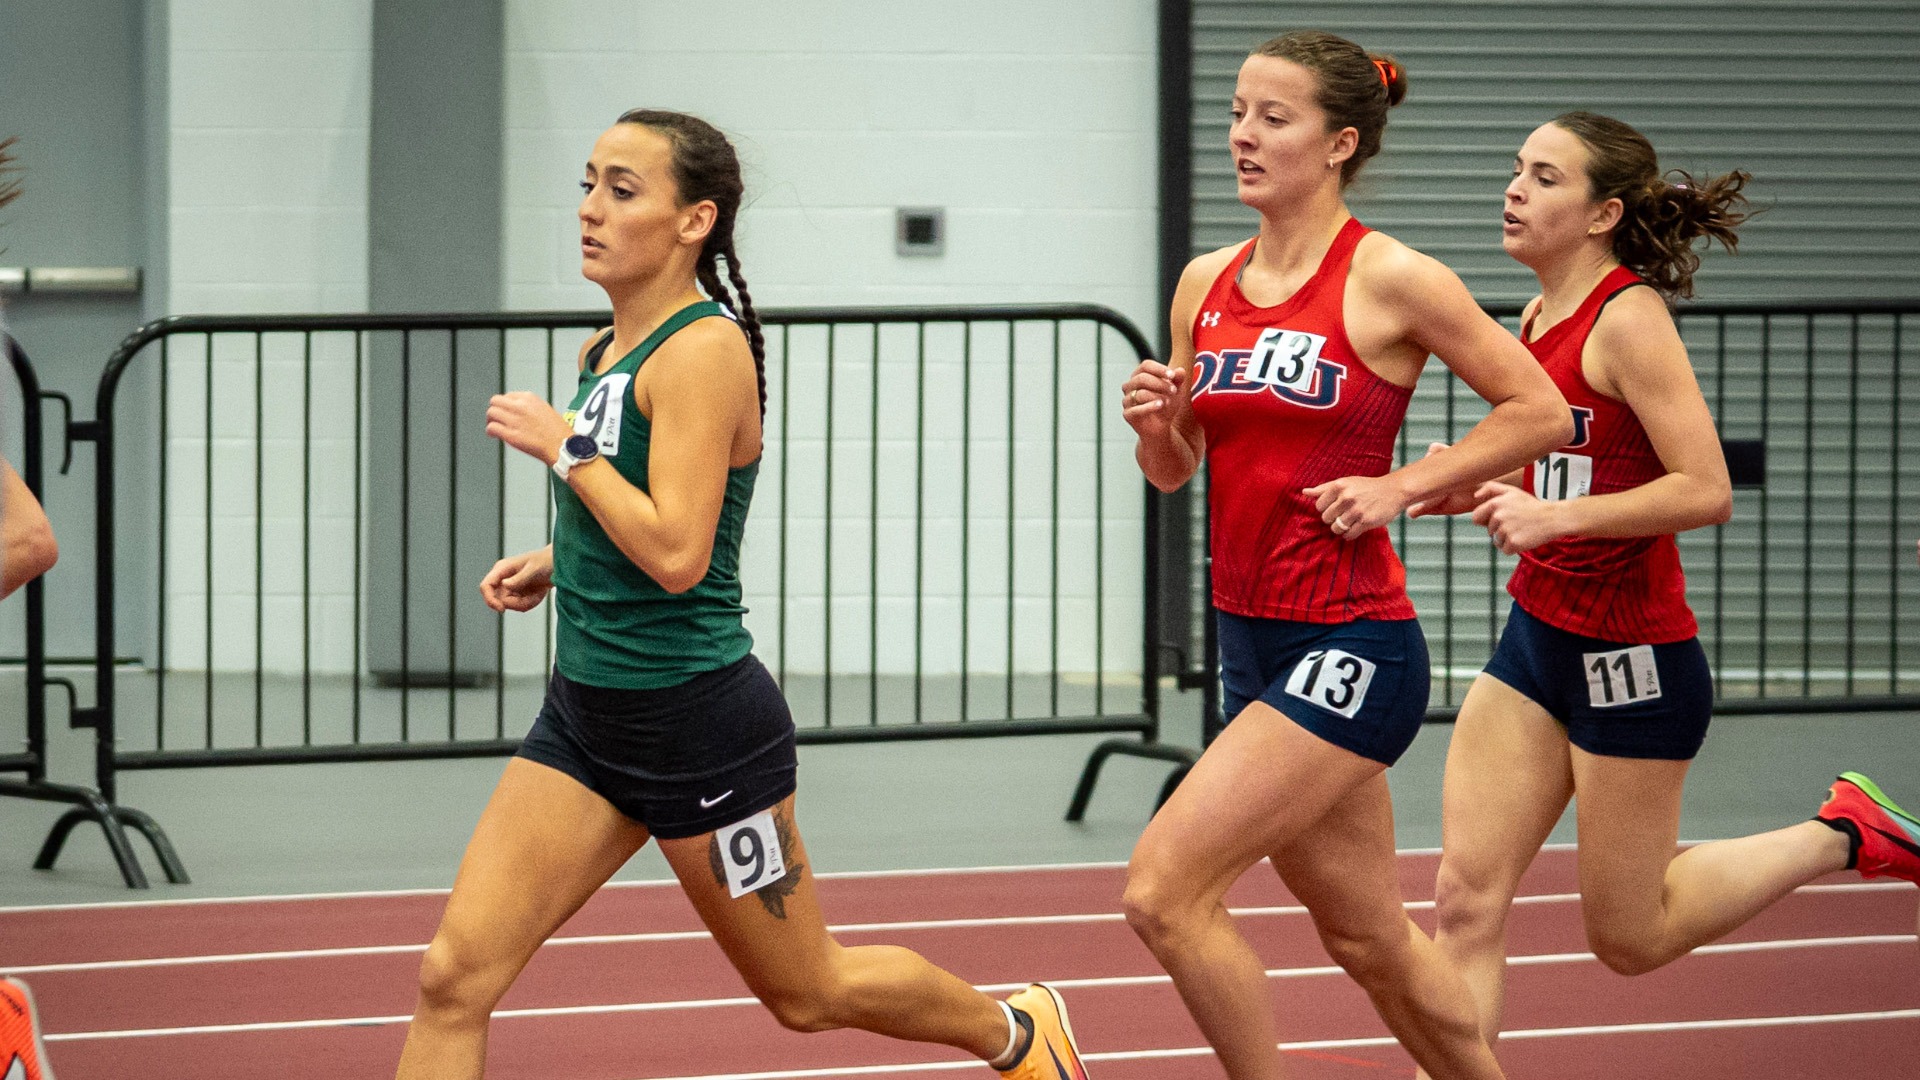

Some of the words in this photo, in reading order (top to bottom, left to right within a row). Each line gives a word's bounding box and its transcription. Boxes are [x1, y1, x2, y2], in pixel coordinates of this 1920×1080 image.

[1257, 331, 1312, 384] 13
[583, 382, 610, 440] 9
[1537, 454, 1569, 500] 11
[1301, 650, 1363, 710] 13
[1590, 652, 1638, 704] 11
[729, 826, 765, 889] 9
